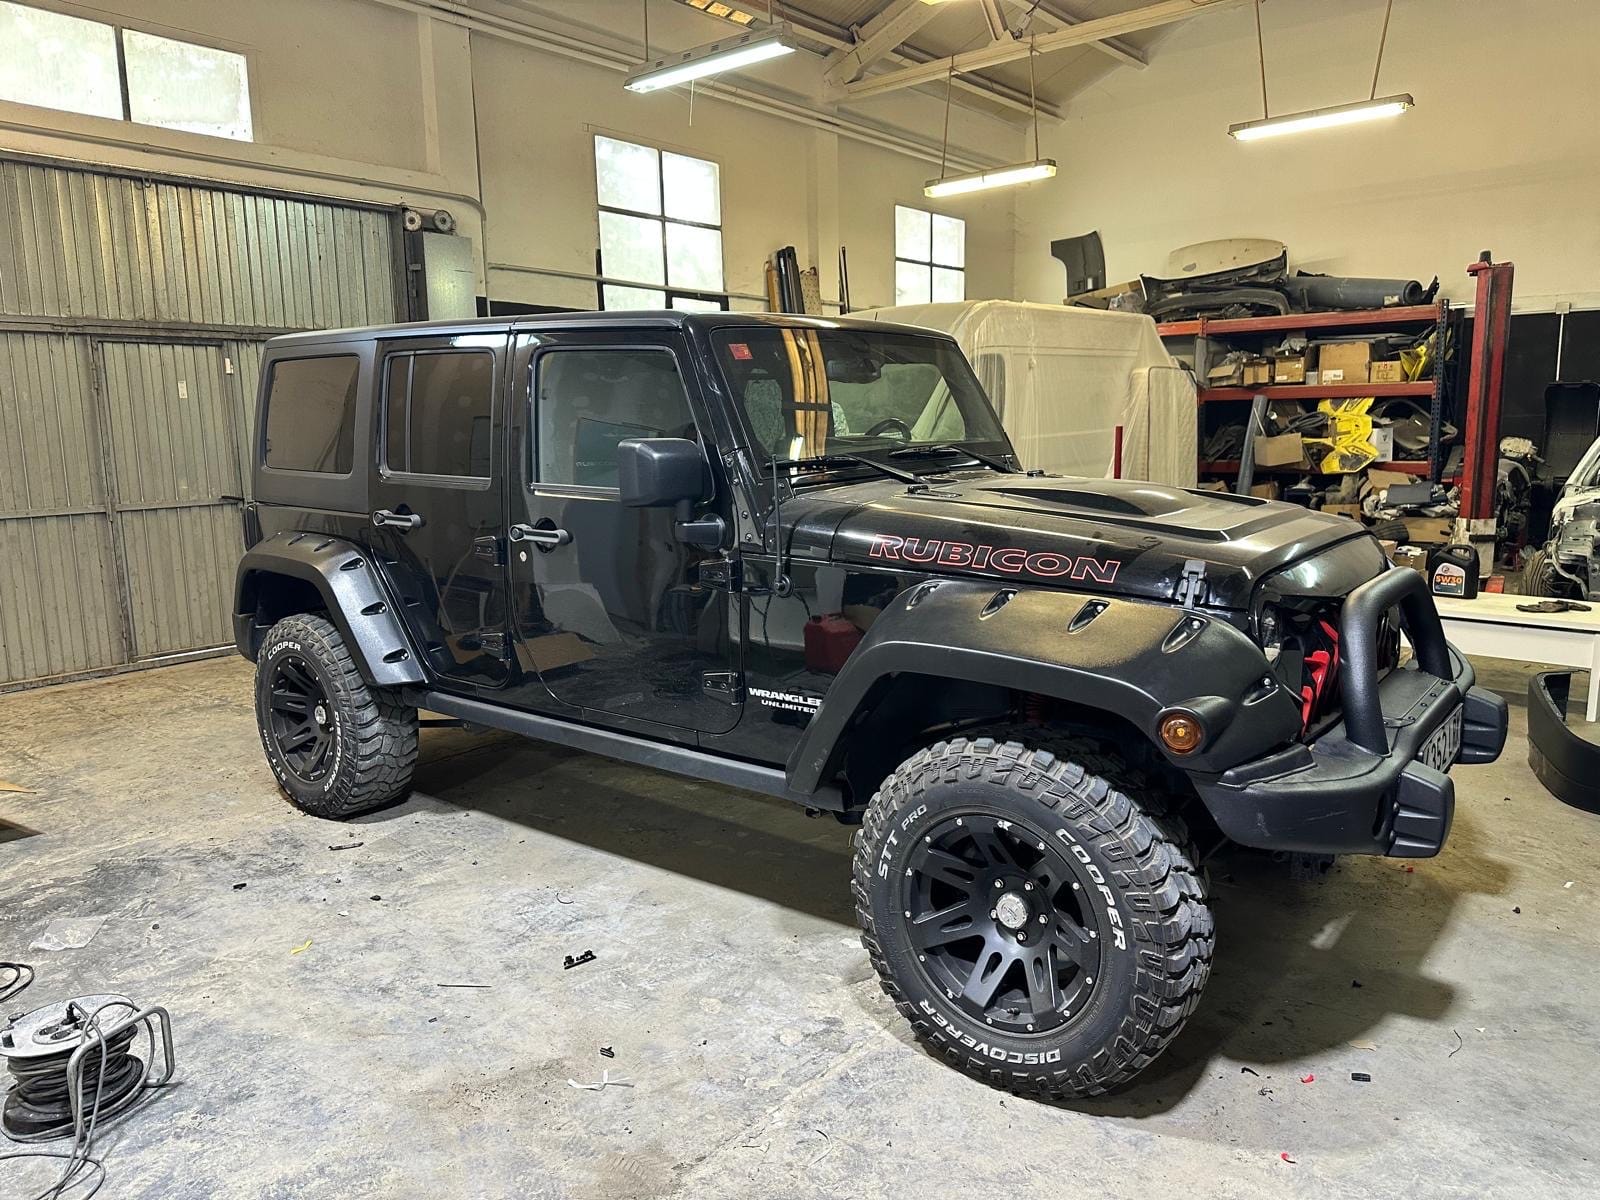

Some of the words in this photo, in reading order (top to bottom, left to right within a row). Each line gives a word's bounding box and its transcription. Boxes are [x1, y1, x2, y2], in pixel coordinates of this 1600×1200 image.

[869, 534, 1121, 583] RUBICON
[267, 641, 301, 660] COOPER
[761, 700, 817, 714] UNLIMITED
[878, 829, 899, 880] STT
[901, 804, 928, 831] PRO
[1056, 828, 1126, 950] COOPER
[919, 999, 1061, 1064] DISCOVERER
